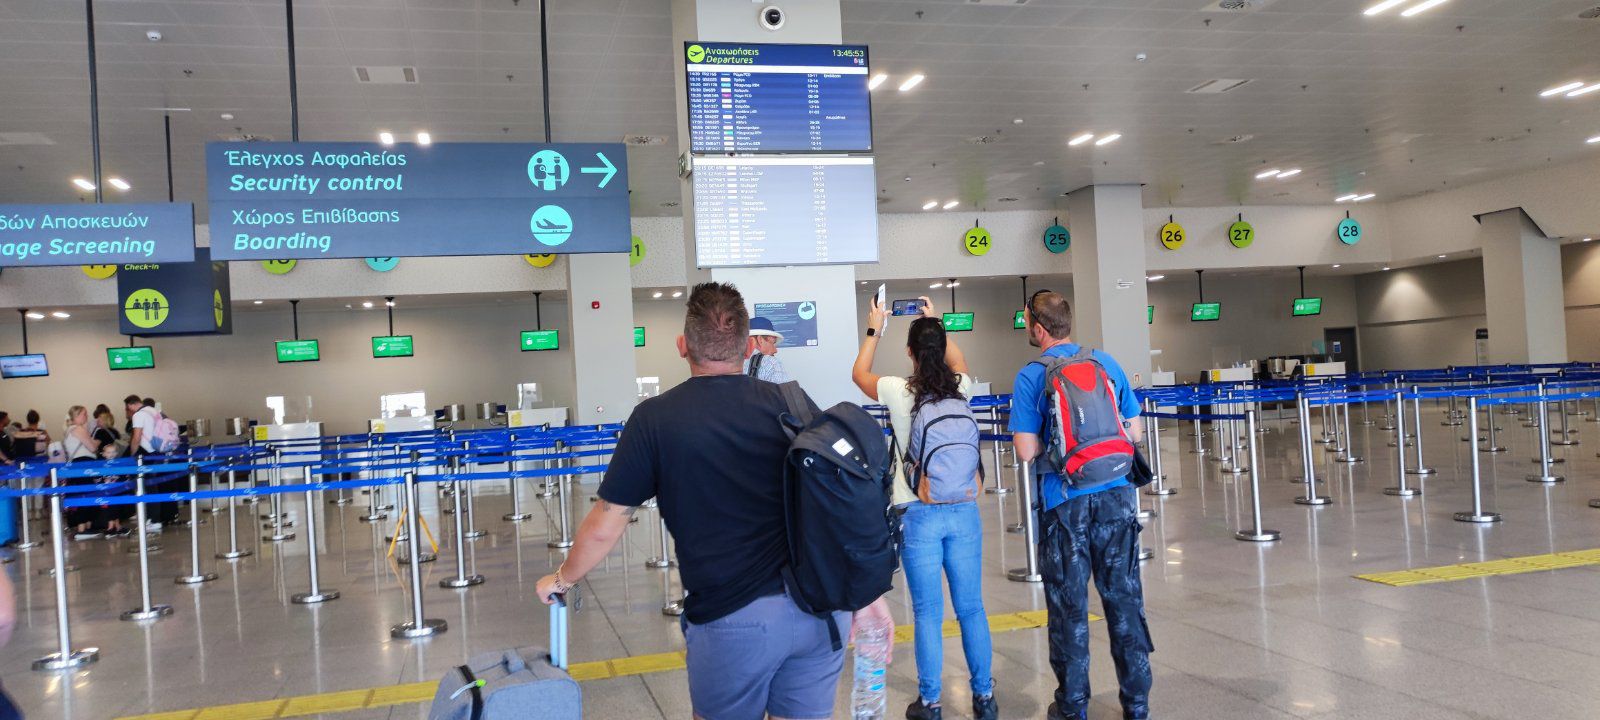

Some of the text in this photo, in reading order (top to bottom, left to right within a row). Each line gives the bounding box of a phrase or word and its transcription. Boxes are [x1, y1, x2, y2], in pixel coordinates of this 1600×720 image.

[705, 46, 760, 56] Αναχωρήσεις
[832, 49, 864, 57] 13:45:53
[706, 55, 754, 64] Departures
[224, 150, 407, 168] Έλεγχος Ασφαλείας
[229, 173, 403, 194] Security control
[41, 212, 149, 229] Αποσκευών
[232, 208, 400, 227] Χώρος Επιβίβασης
[1165, 230, 1183, 242] 26
[1233, 229, 1251, 241] 27
[1342, 226, 1359, 237] 28
[234, 232, 331, 252] Boarding
[969, 235, 988, 248] 24
[1049, 233, 1067, 246] 25
[0, 237, 155, 259] age Screening
[124, 263, 160, 271] Check-in
